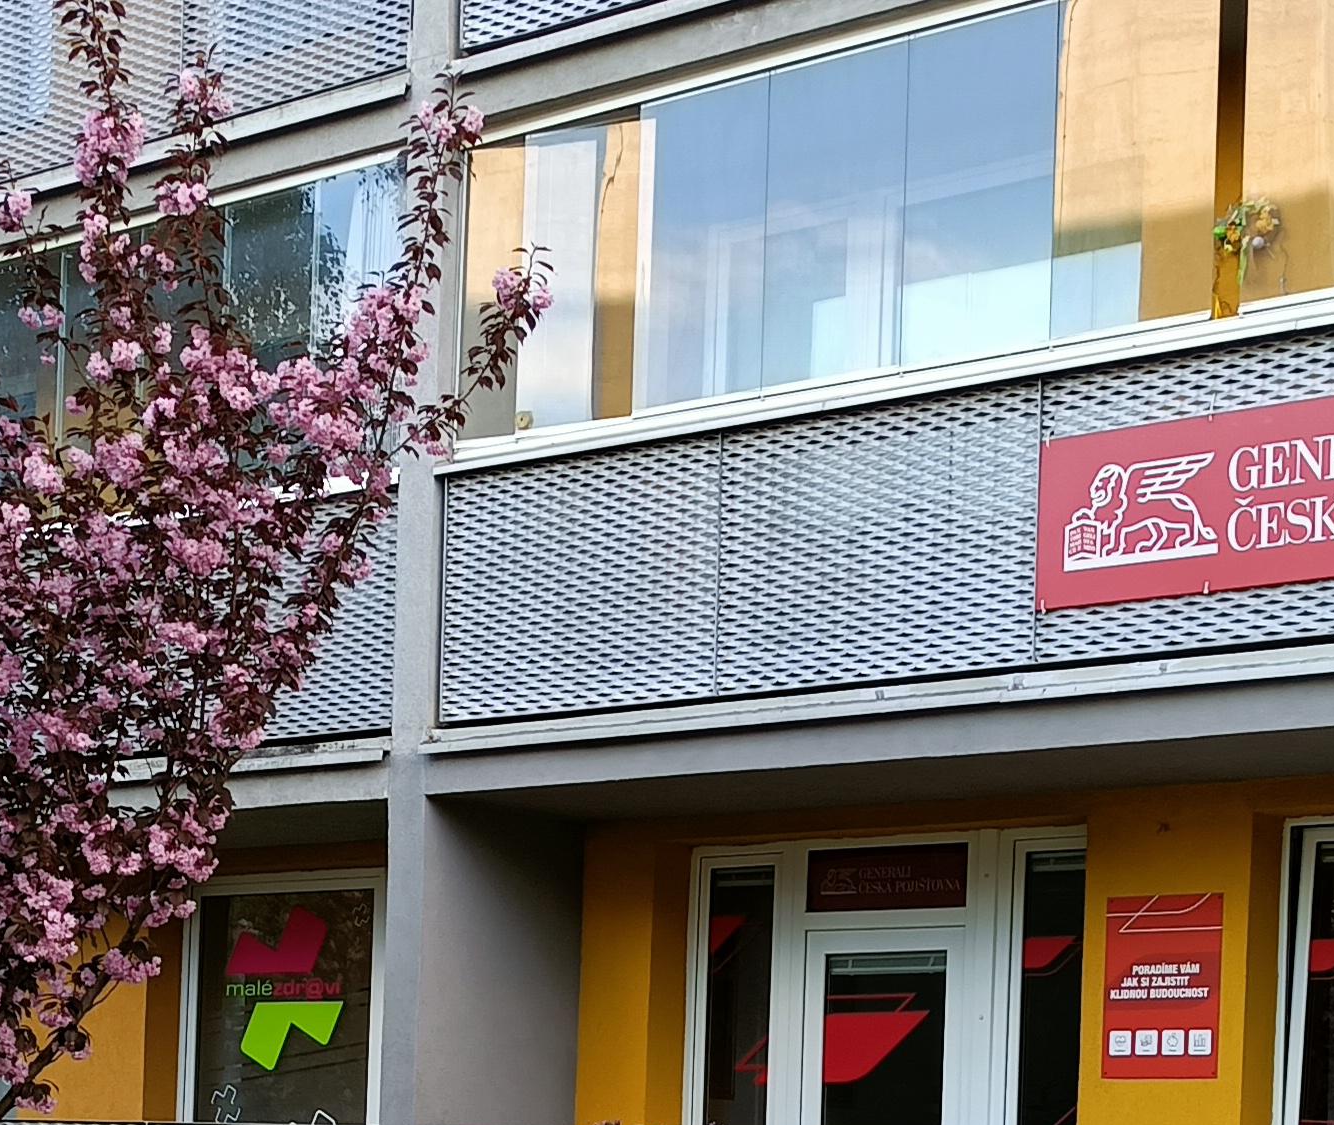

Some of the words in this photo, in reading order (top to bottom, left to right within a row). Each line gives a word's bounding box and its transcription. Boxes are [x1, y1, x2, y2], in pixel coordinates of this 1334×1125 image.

[1132, 962, 1178, 976] PORADÍME
[1179, 961, 1200, 974] VÁM
[1121, 977, 1139, 988] JAK
[1140, 977, 1150, 987] SI
[1151, 975, 1190, 987] ZAJISTIT
[1109, 988, 1148, 1000] KLIDNOU
[1149, 987, 1209, 999] BUDOUCNOST
